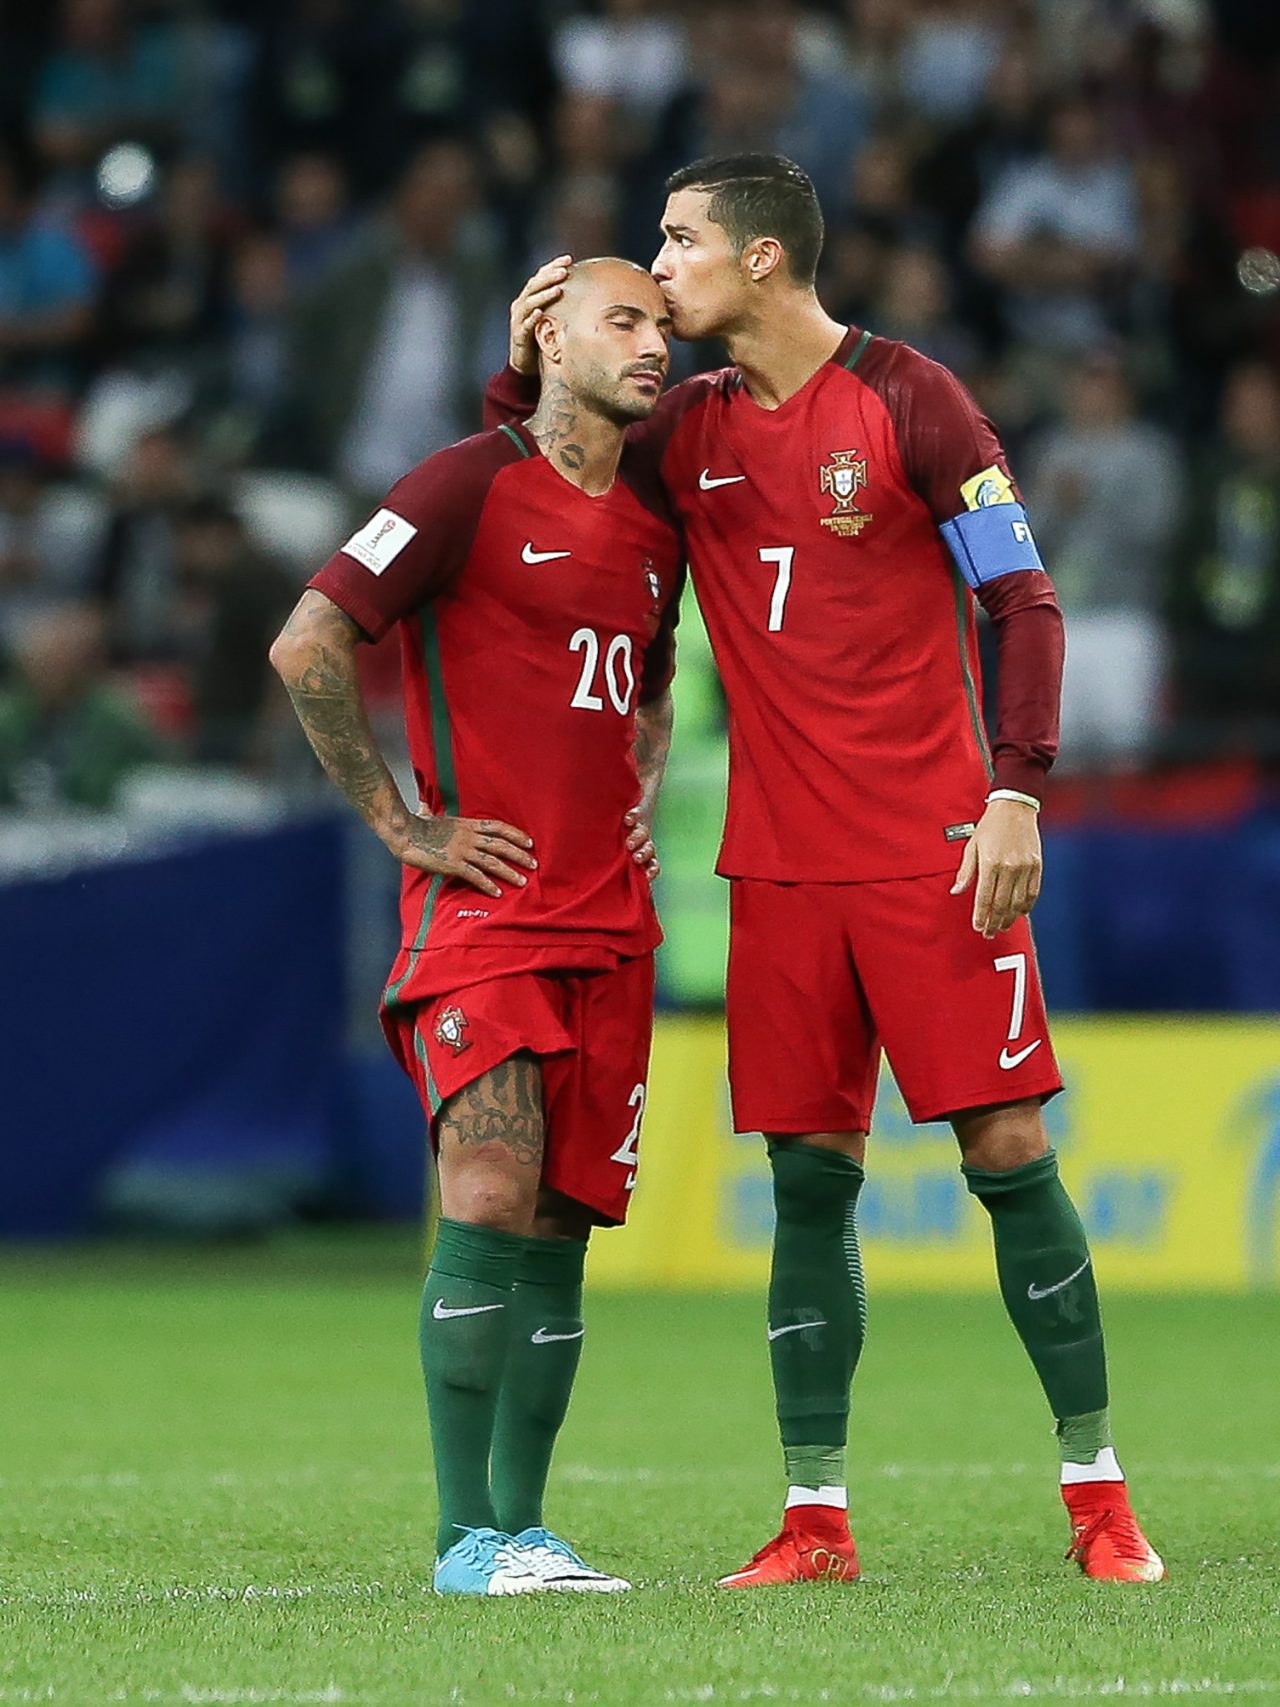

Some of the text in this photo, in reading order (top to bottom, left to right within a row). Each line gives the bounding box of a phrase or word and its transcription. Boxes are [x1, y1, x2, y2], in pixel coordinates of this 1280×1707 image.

[759, 546, 794, 632] 7
[568, 627, 635, 716] 20
[993, 952, 1028, 1041] 7
